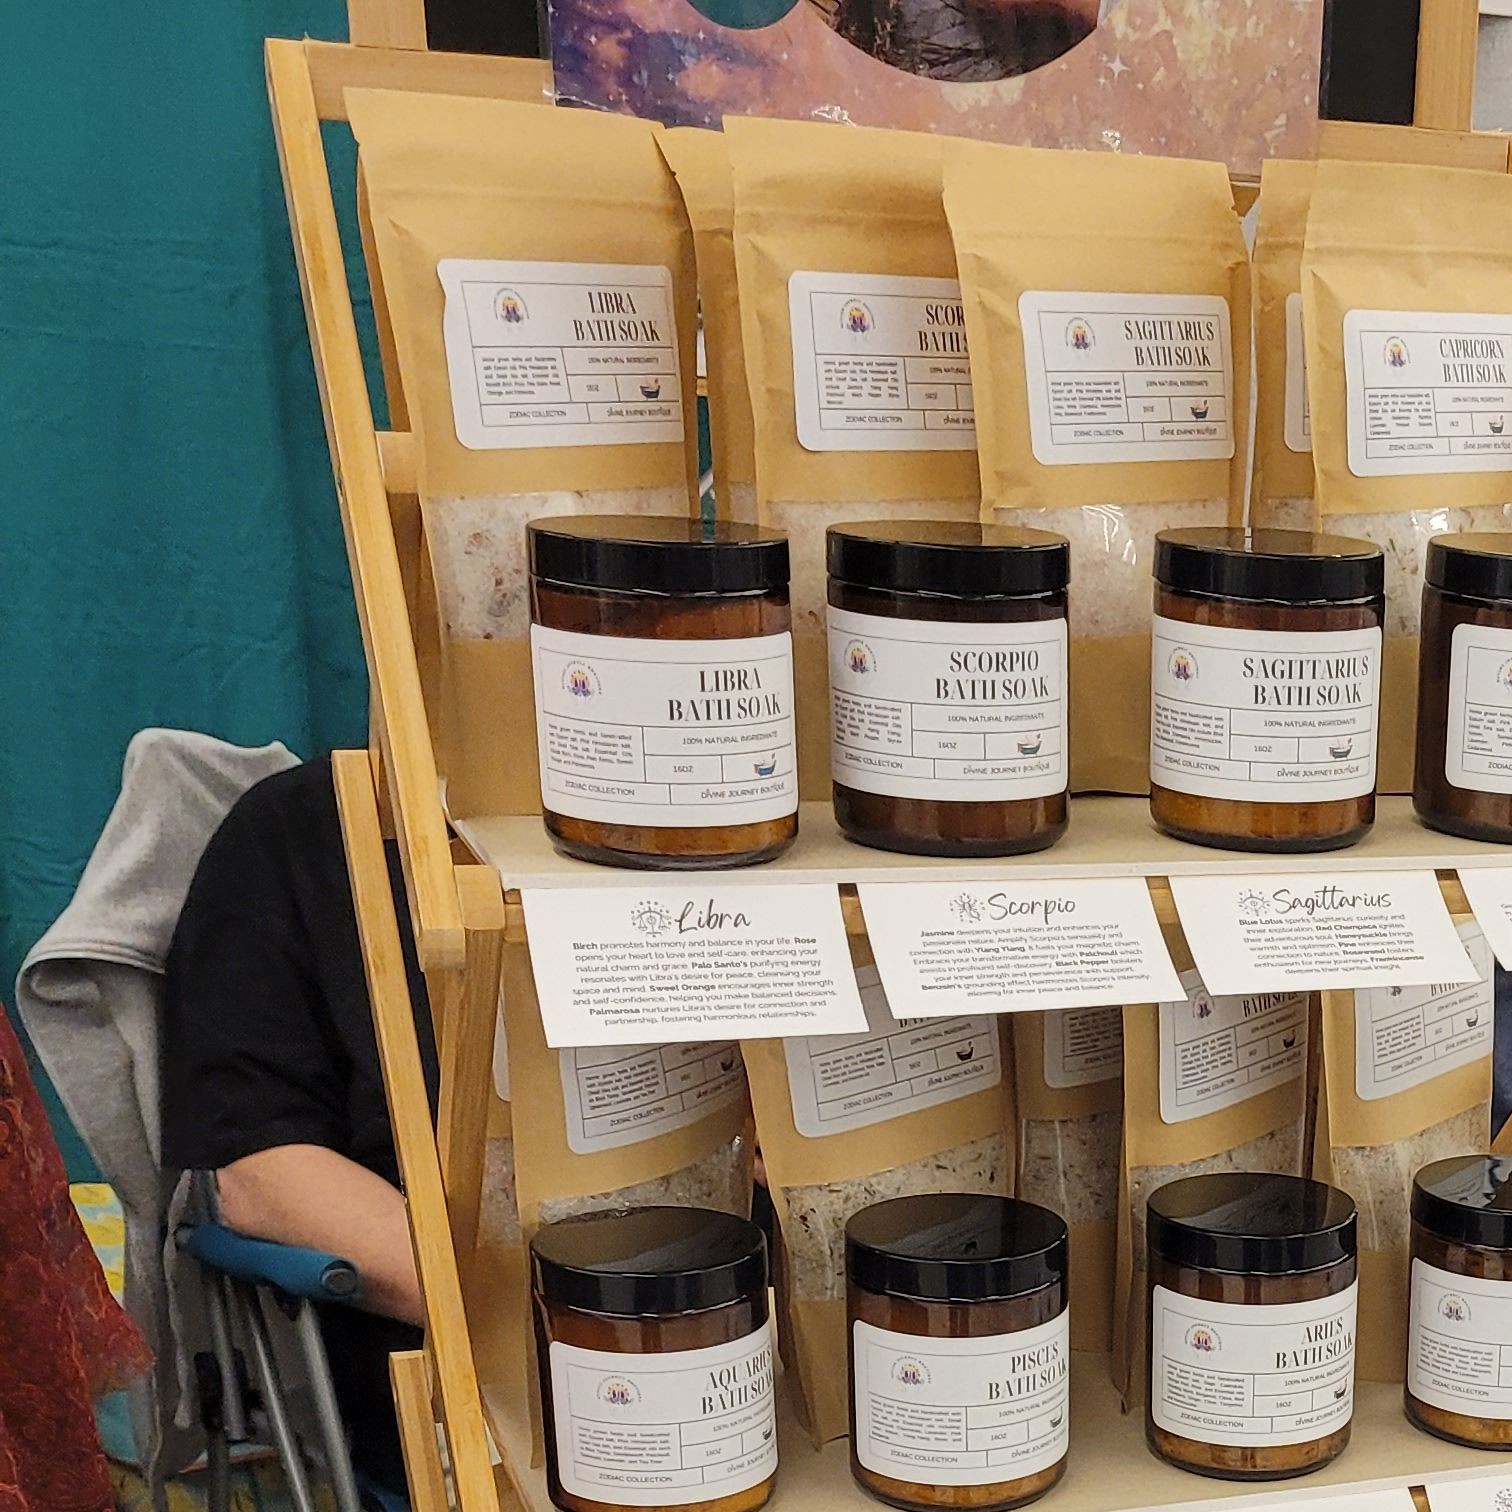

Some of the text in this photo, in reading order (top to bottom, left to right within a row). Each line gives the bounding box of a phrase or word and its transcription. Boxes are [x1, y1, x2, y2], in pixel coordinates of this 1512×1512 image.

[588, 292, 637, 314] LIBRA
[573, 320, 660, 342] BATH SOAK
[918, 331, 962, 351] BATH
[1124, 320, 1214, 342] SAGITTARIUS
[1135, 347, 1211, 366] BATH SOAK
[1439, 339, 1505, 359] CAPRICORN
[1443, 364, 1506, 383] BATH SOAK
[950, 650, 1039, 673] SCORPIO
[1242, 655, 1369, 680] SAGITTARIUS
[699, 668, 761, 692] LIBRA
[936, 676, 1048, 700] BATH SOAK
[1253, 682, 1362, 706] BATH SOAK
[668, 693, 781, 721] BATH SOAK
[1284, 720, 1316, 728] NATURAL
[705, 734, 738, 744] NATURAL
[1488, 762, 1512, 770] ZODIAC
[588, 785, 635, 796] COLLECTION
[988, 893, 1076, 924] Scorpio
[1272, 886, 1392, 916] Sagittarius
[675, 899, 751, 935] Libra
[1301, 1316, 1343, 1344] ARIES
[1011, 1341, 1059, 1374] PISCES
[1276, 1332, 1352, 1369] BATH SOAK
[988, 1358, 1066, 1400] BATH SOAK
[701, 1387, 748, 1415] BATH
[1452, 1385, 1489, 1396] COLLECTION
[1203, 1417, 1244, 1427] COLLECTION
[915, 1453, 958, 1463] COLLECTION
[599, 1473, 672, 1483] ZODIAC COLLECTION
